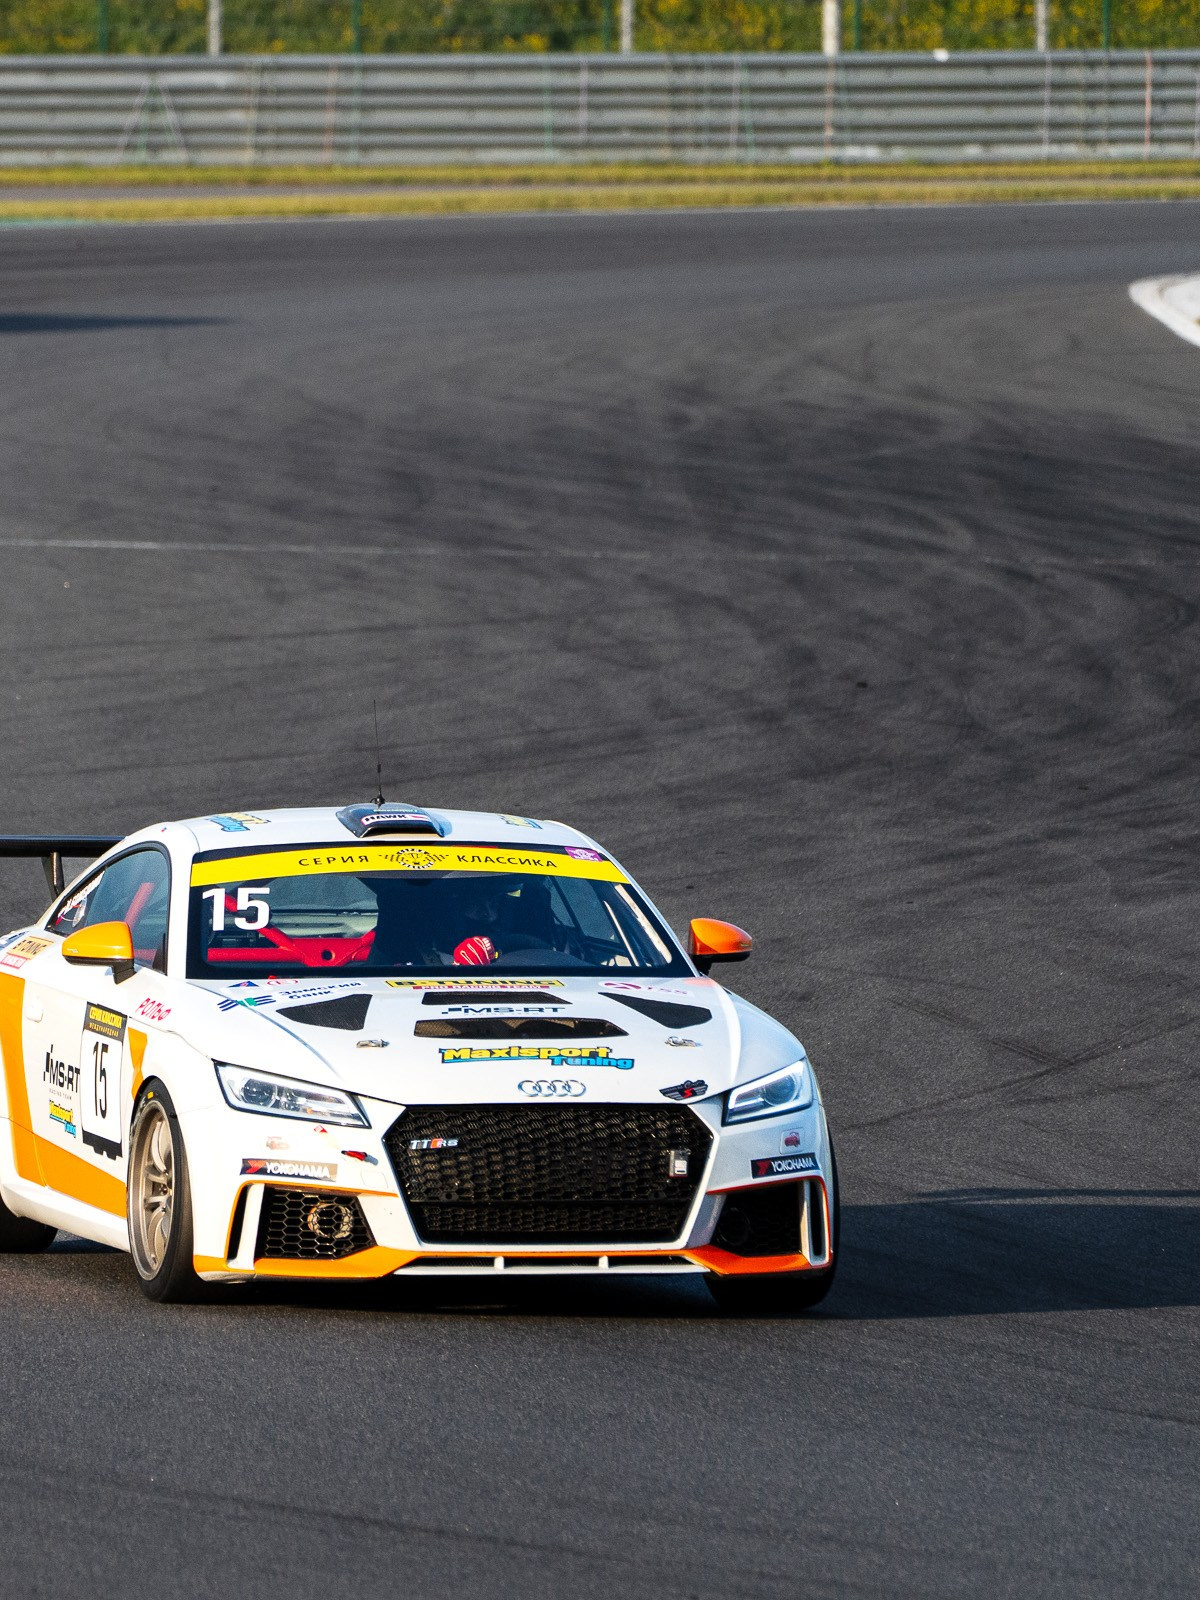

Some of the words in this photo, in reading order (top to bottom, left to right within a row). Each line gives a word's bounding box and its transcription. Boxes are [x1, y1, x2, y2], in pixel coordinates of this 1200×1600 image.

[365, 814, 407, 822] HAWK
[298, 855, 369, 867] СЕРИЯ
[456, 854, 557, 868] КЛАССИКА
[202, 887, 270, 931] 15
[441, 1046, 612, 1060] Maxisport
[551, 1056, 635, 1070] Tuning
[93, 1041, 109, 1119] 15
[265, 1161, 331, 1178] YOKOHAMA
[771, 1157, 815, 1172] YOKOHAMA
